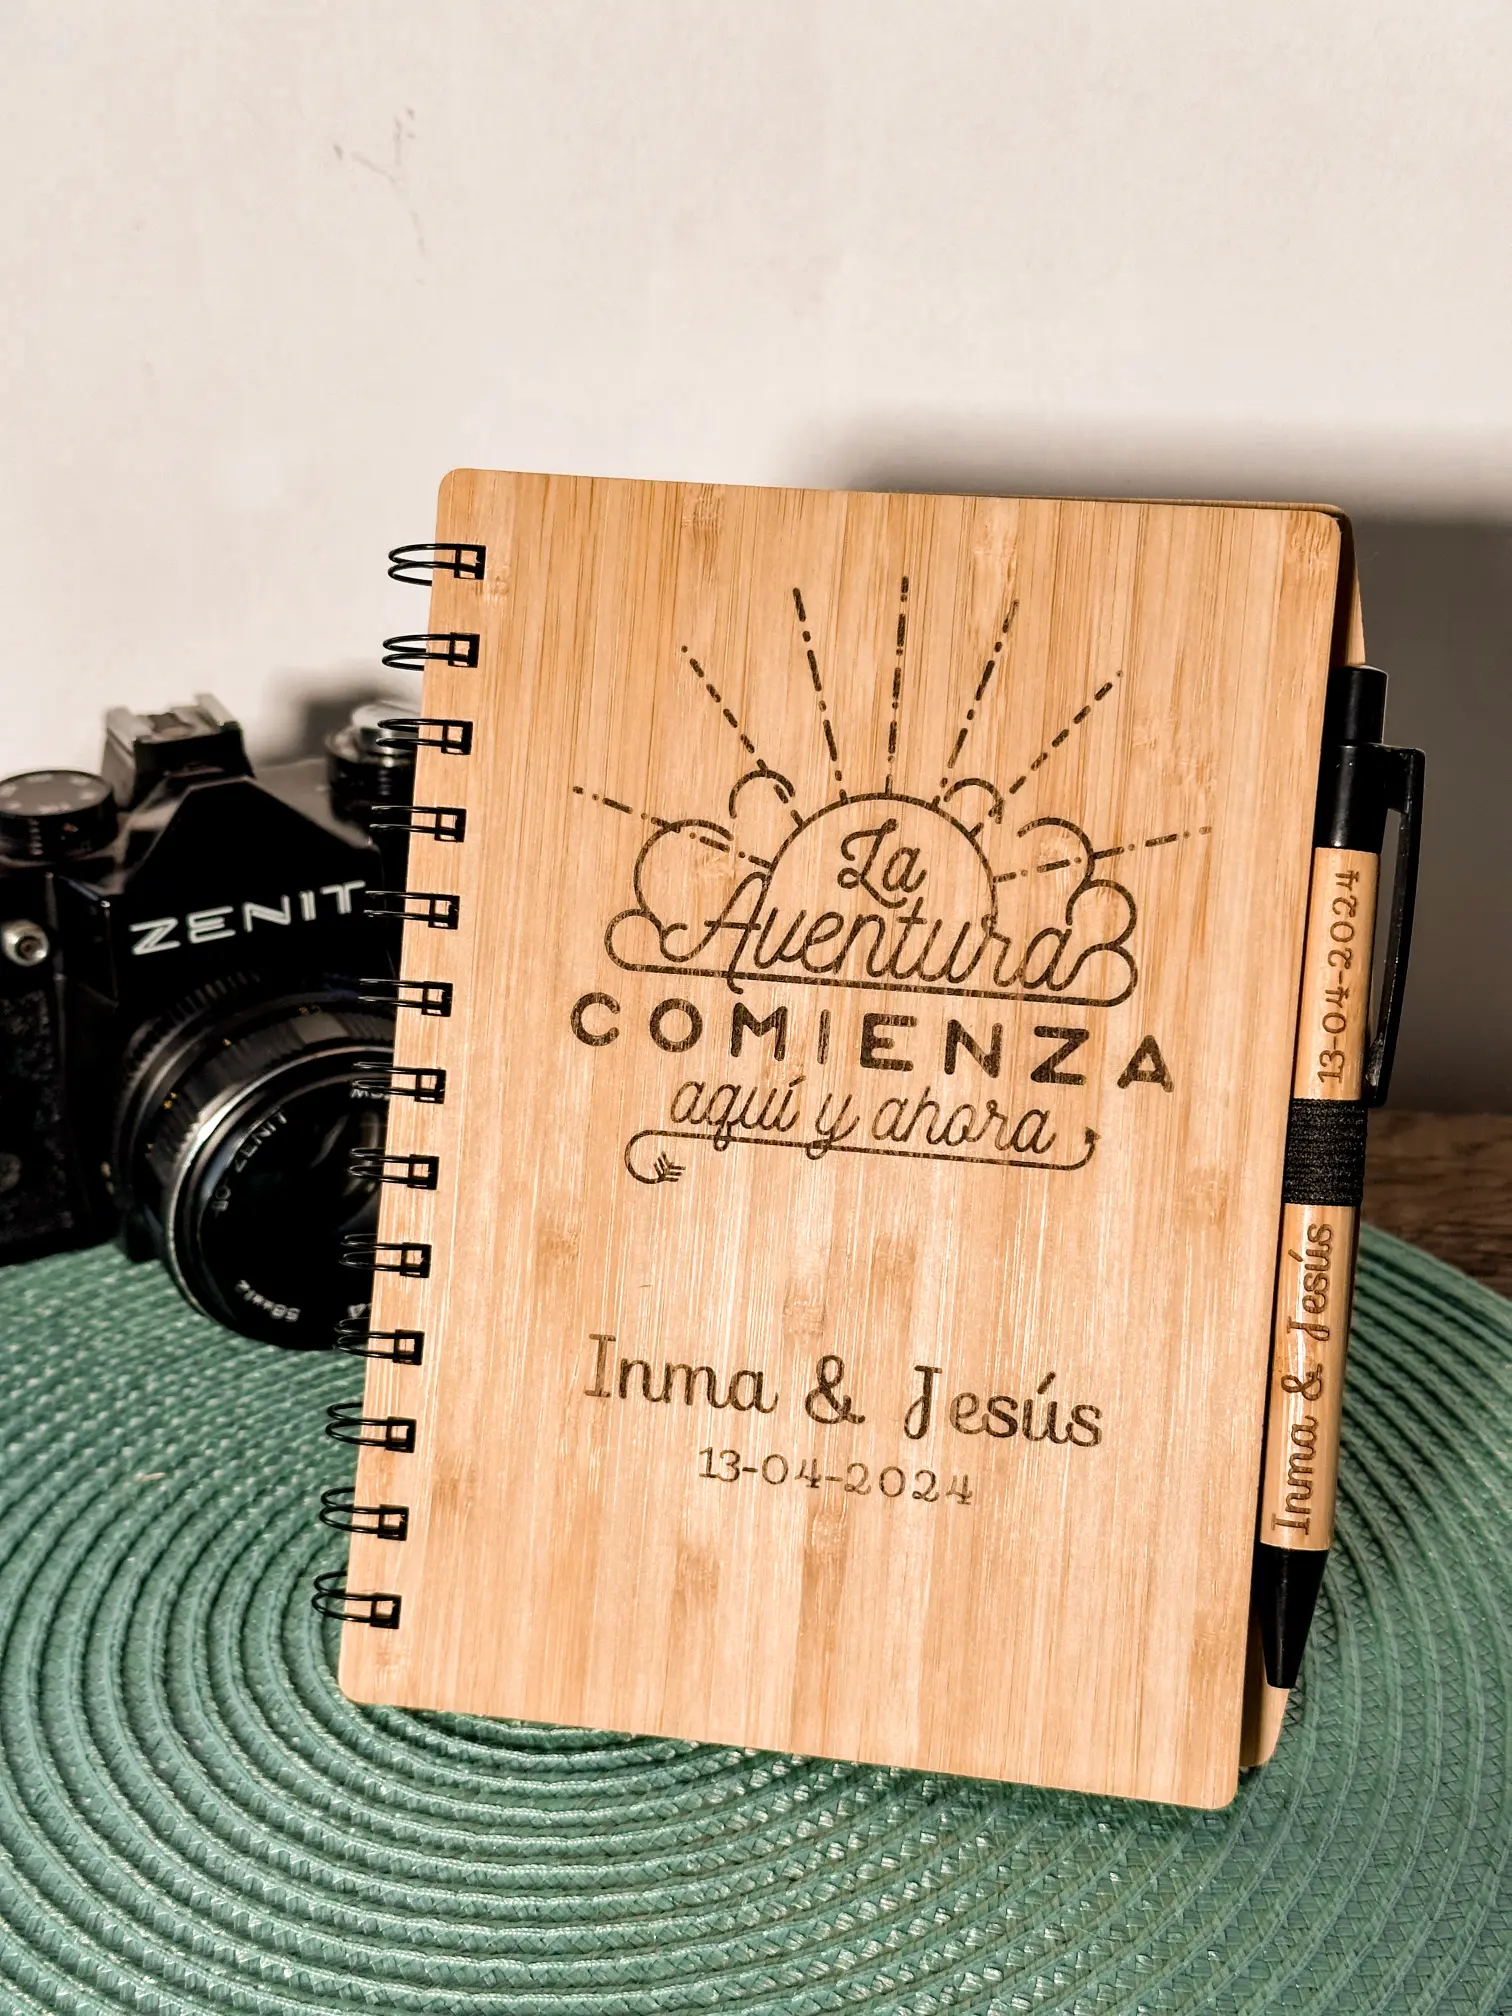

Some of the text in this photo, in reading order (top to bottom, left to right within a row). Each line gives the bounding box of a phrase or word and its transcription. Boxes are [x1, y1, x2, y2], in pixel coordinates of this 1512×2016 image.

[838, 819, 928, 909] La
[129, 880, 366, 956] ZENIT
[660, 871, 1076, 993] Aventura
[1316, 869, 1361, 1084] 13-04-2024
[571, 991, 1174, 1094] COMIENZA
[671, 1075, 1056, 1161] aquí y ahora
[582, 1332, 1104, 1449] Inma & Jesús
[1271, 1222, 1335, 1537] Inma & Jesús
[698, 1445, 975, 1507] 13-04-2024
